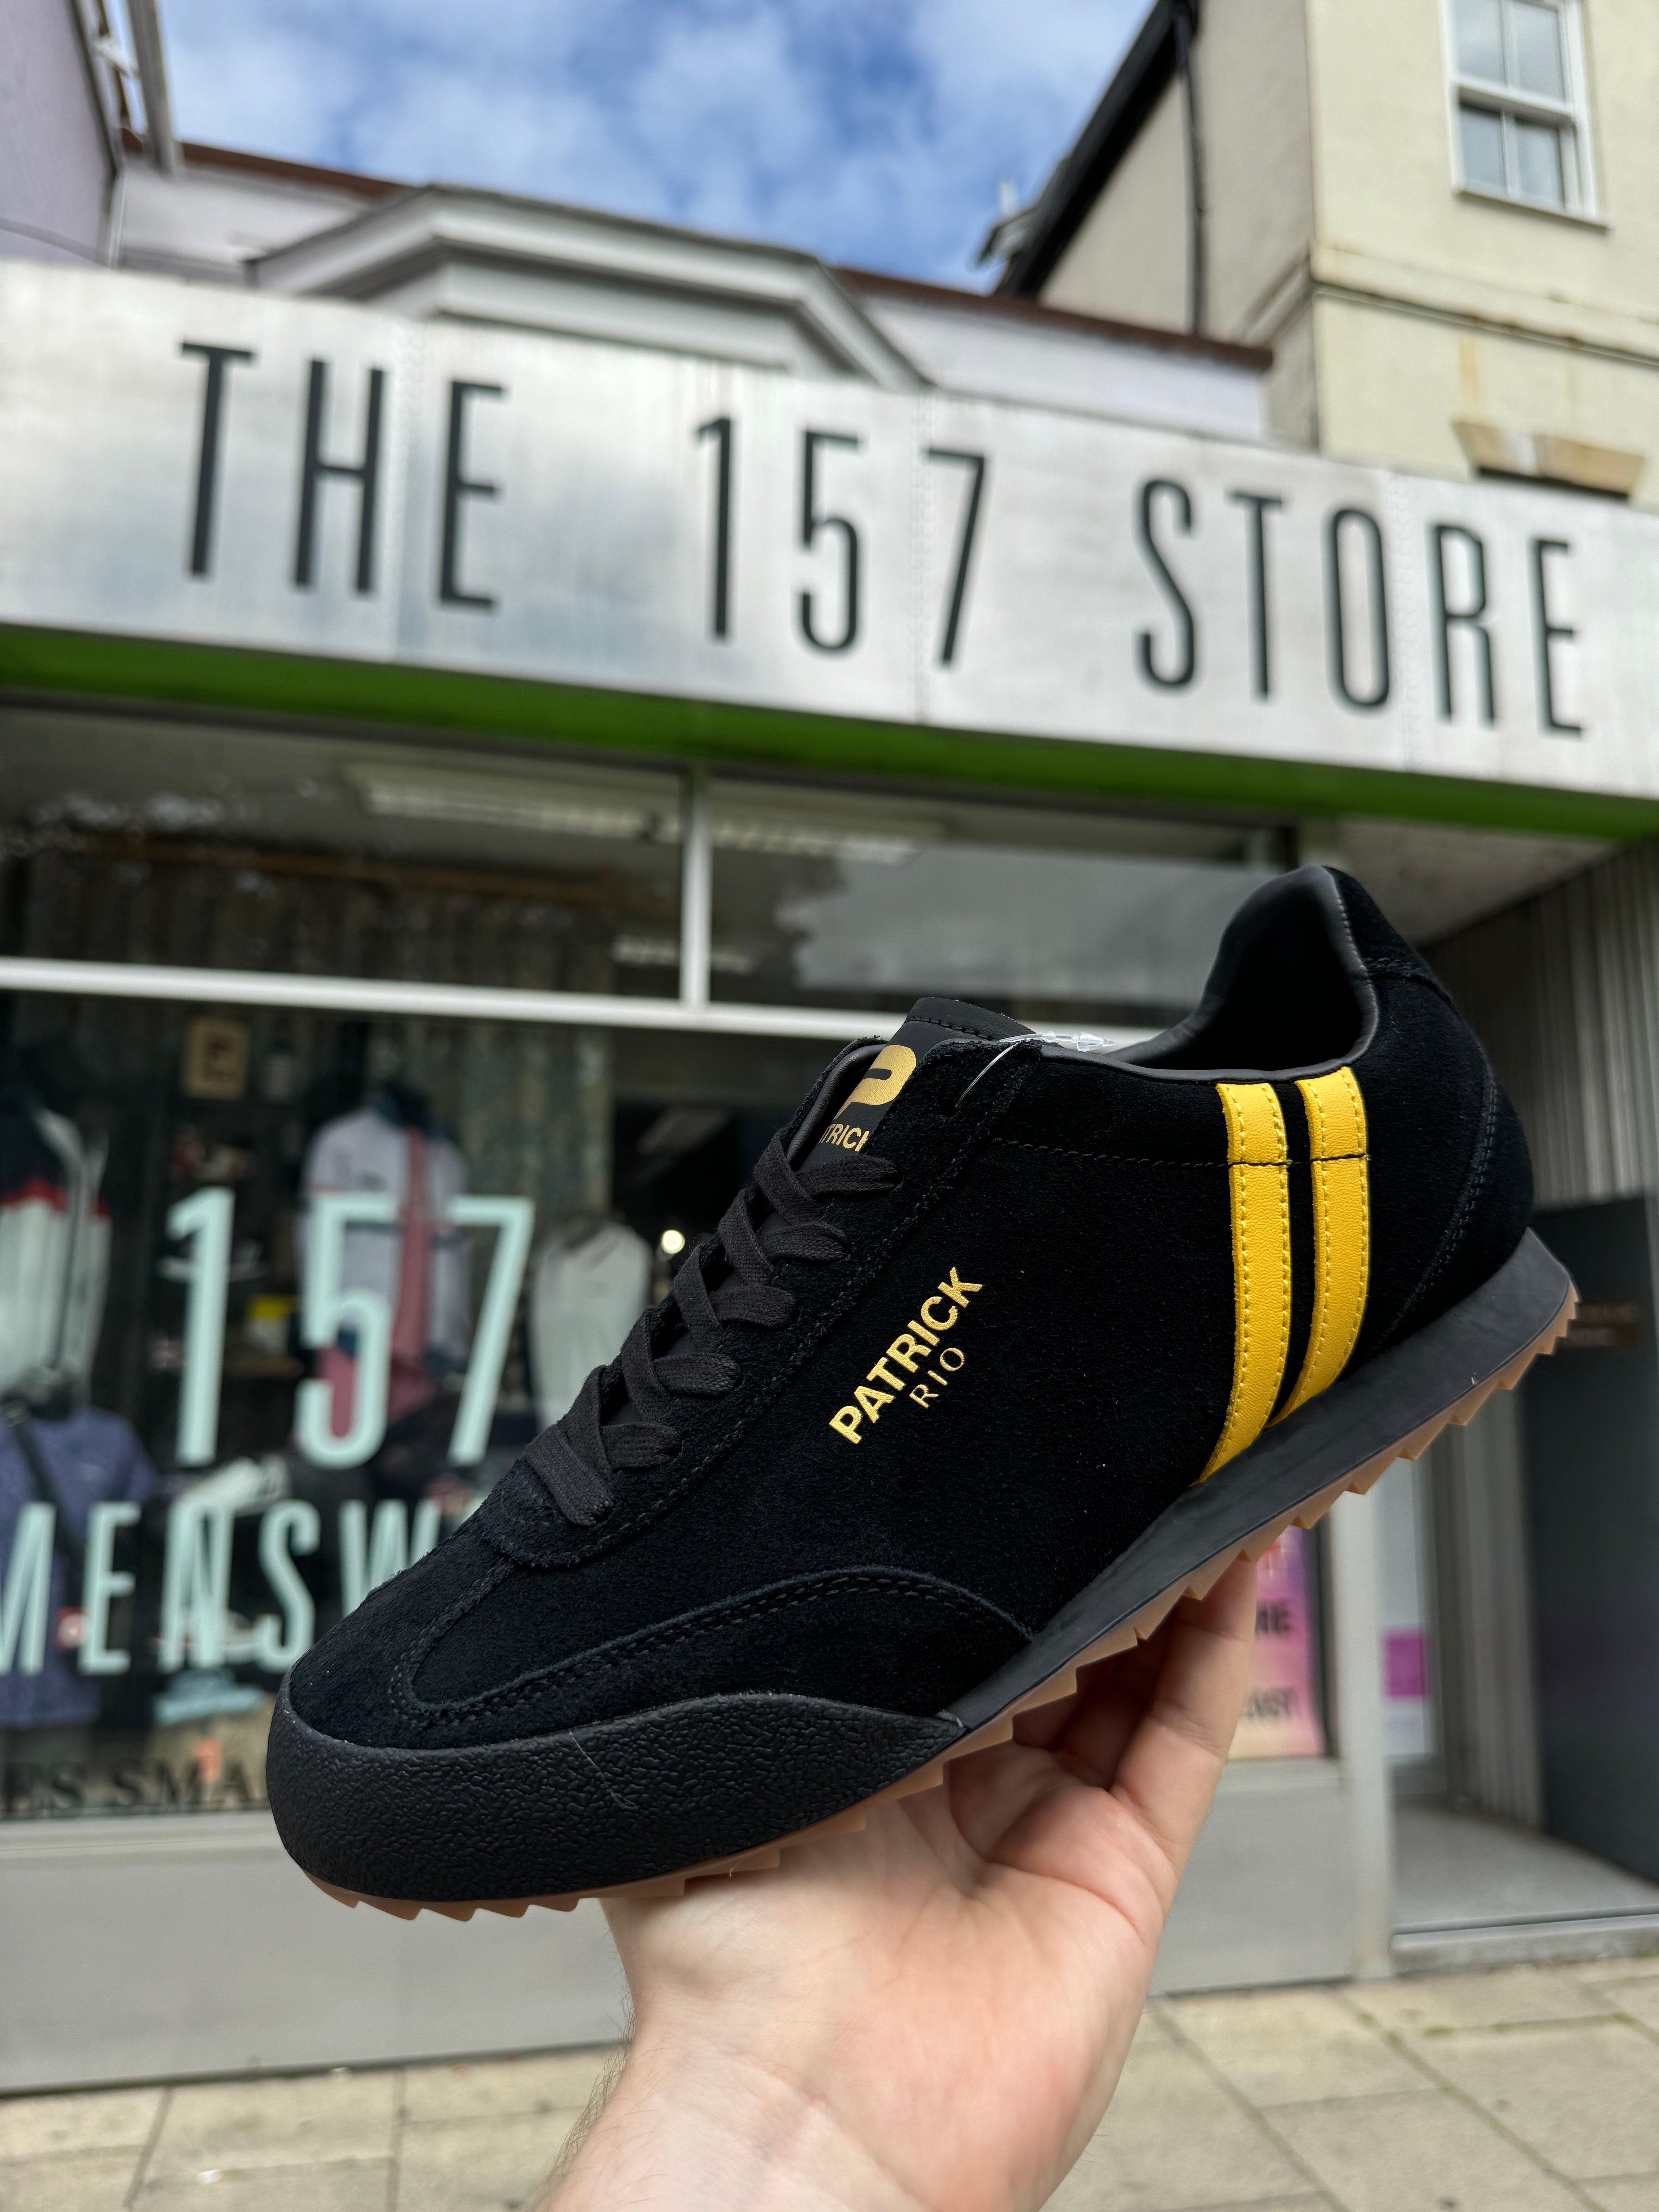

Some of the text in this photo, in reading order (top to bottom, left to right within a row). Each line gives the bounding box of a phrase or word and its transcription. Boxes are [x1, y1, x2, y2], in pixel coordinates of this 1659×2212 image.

[179, 339, 1585, 739] THE 157 STORE
[166, 1187, 535, 1468] 157
[829, 1266, 984, 1444] PATRICK
[909, 1348, 965, 1409] RIO
